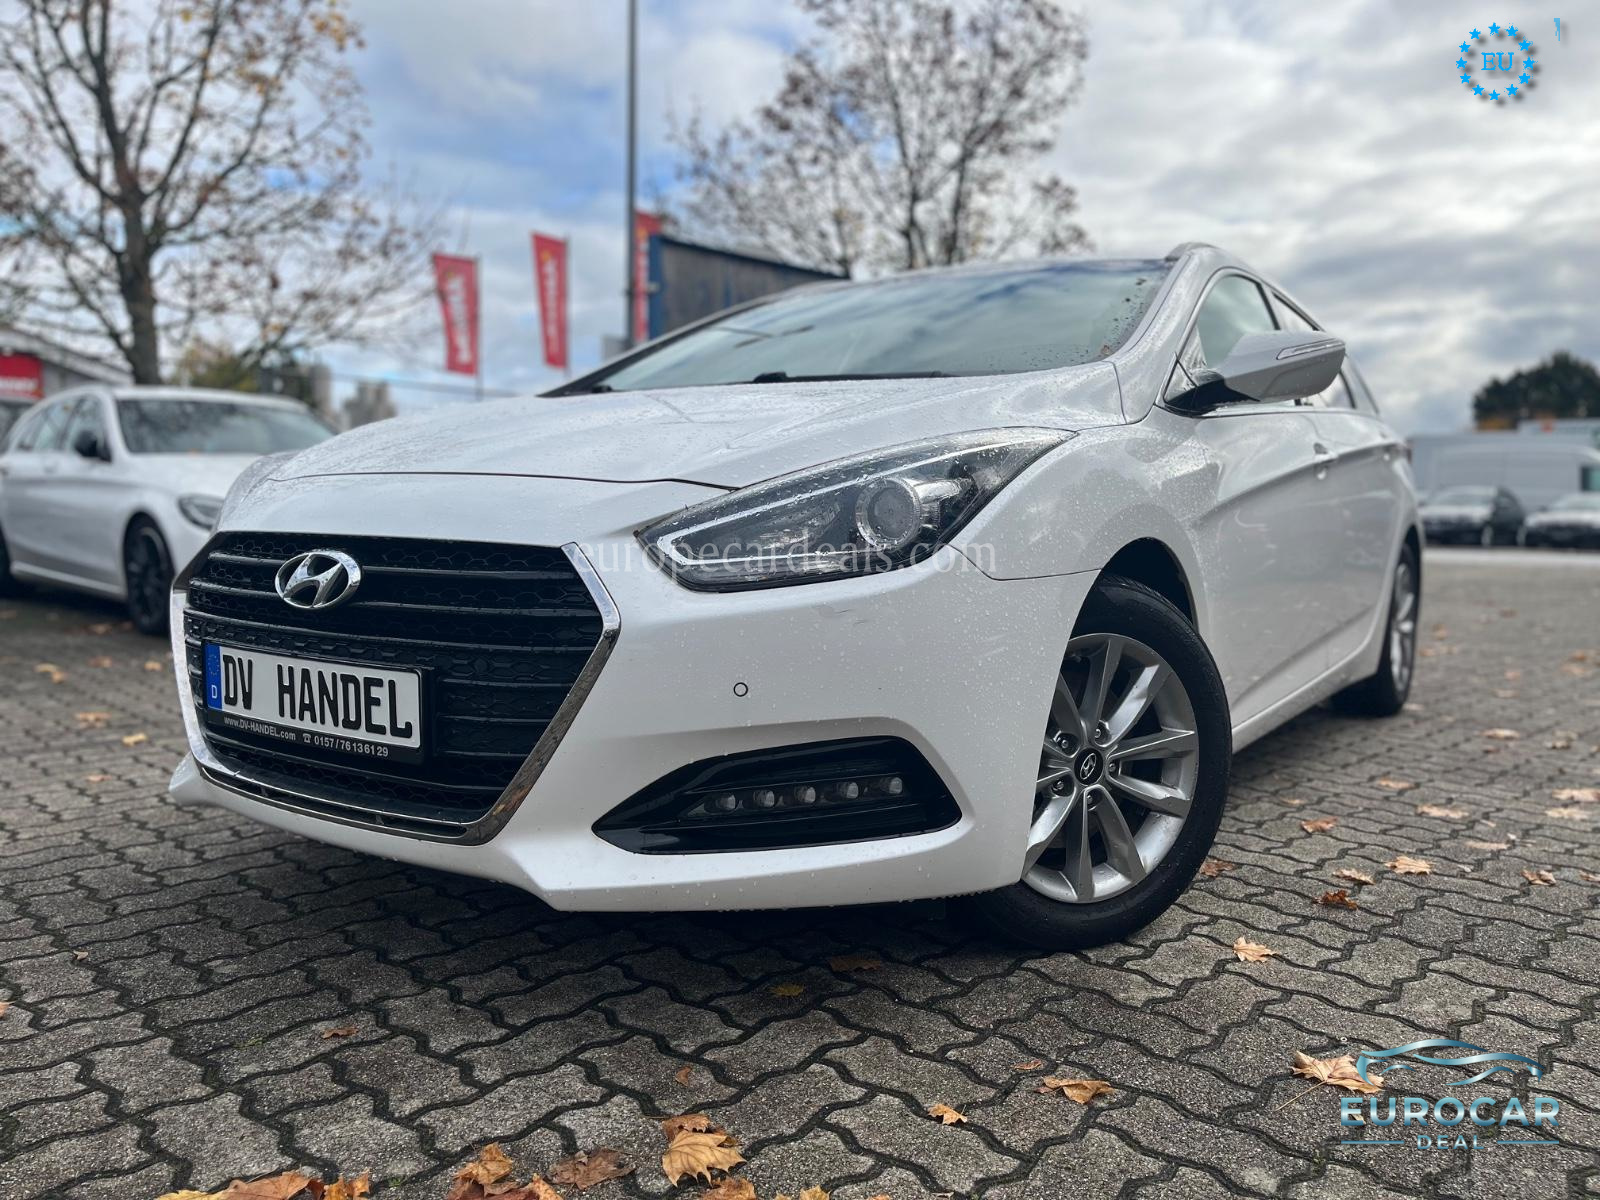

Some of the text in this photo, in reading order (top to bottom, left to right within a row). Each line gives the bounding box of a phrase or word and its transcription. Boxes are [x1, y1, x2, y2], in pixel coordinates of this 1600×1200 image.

[211, 684, 218, 699] D
[222, 654, 413, 739] DV HANDEL
[223, 716, 297, 741] www.DV-HANDEL.com
